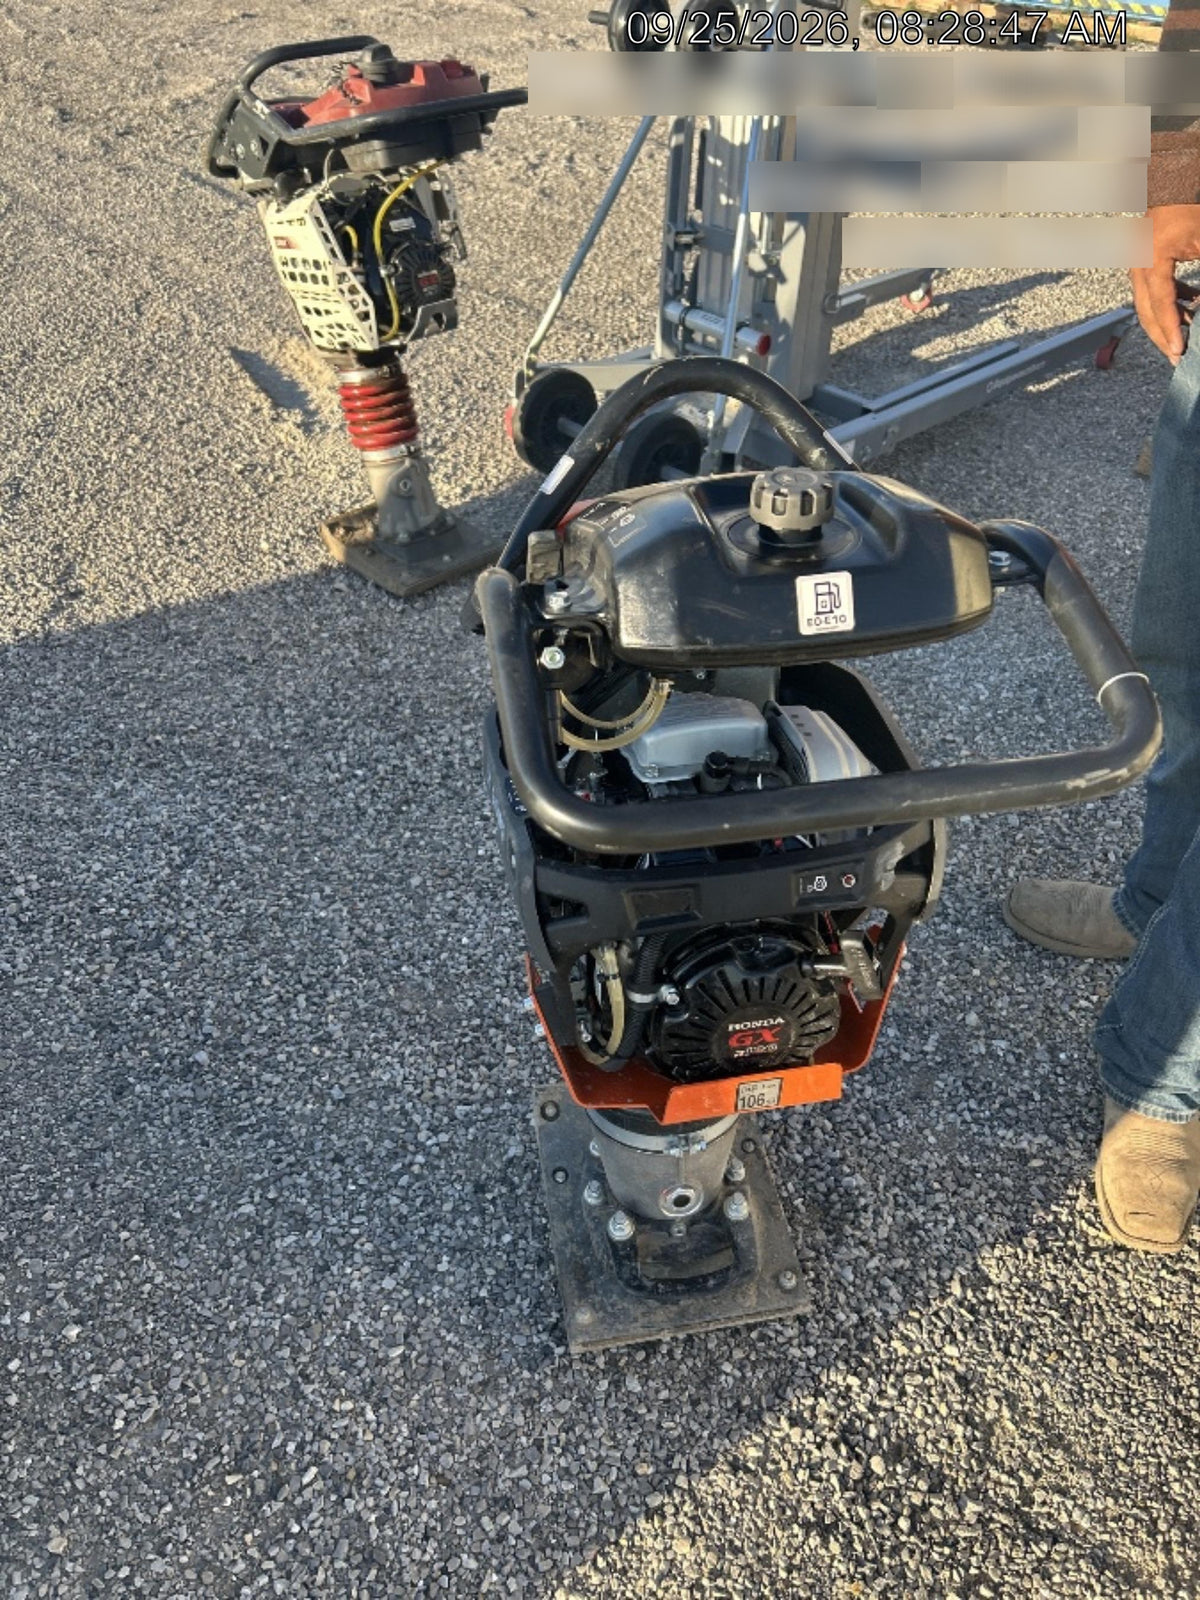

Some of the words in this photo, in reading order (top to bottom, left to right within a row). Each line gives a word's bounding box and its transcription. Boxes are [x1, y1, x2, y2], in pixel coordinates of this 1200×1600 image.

[728, 1017, 785, 1031] HONDA
[728, 1027, 781, 1047] GX
[739, 1094, 765, 1108] 106
